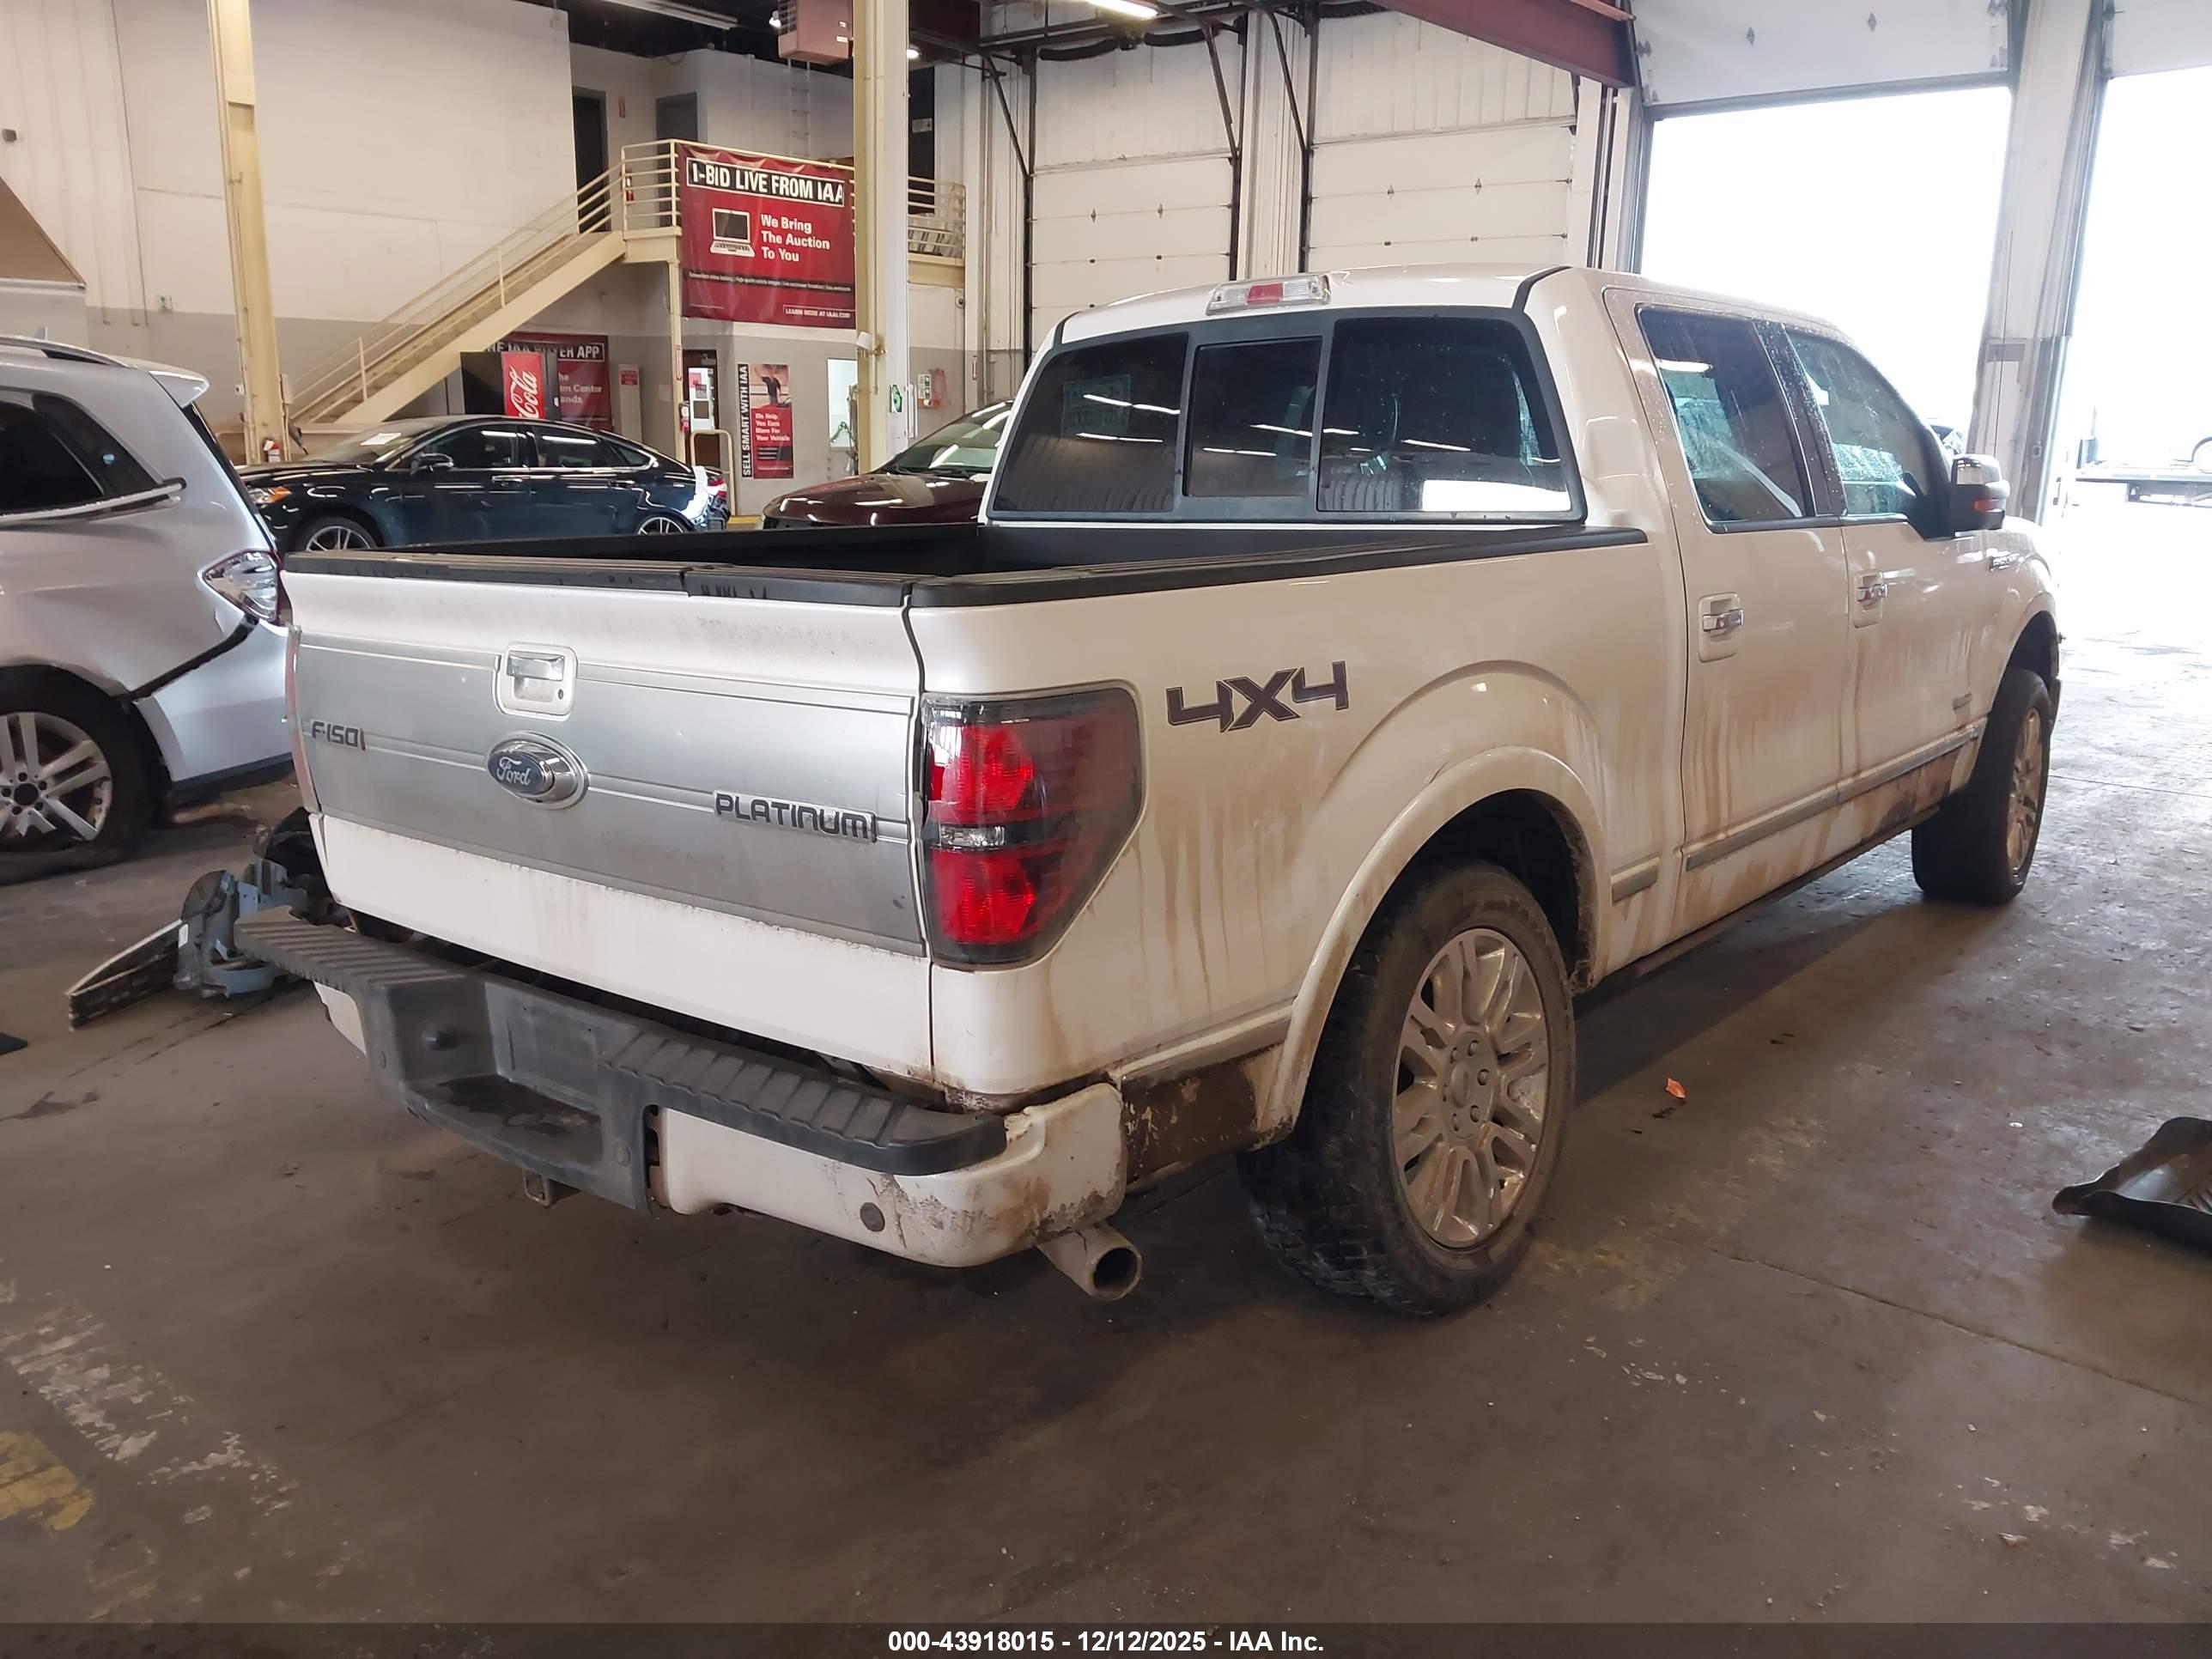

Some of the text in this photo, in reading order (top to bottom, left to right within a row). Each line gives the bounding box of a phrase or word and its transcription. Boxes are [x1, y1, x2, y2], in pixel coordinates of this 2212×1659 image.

[692, 162, 843, 203] I-BID LIVE FROM IAA
[761, 214, 812, 234] We Bring
[761, 230, 830, 250] The Auction
[761, 246, 799, 262] To You
[577, 345, 600, 359] APP
[739, 366, 751, 476] SELL SMART WITH IAA
[496, 756, 531, 787] Ford
[715, 793, 869, 840] PLATINUM
